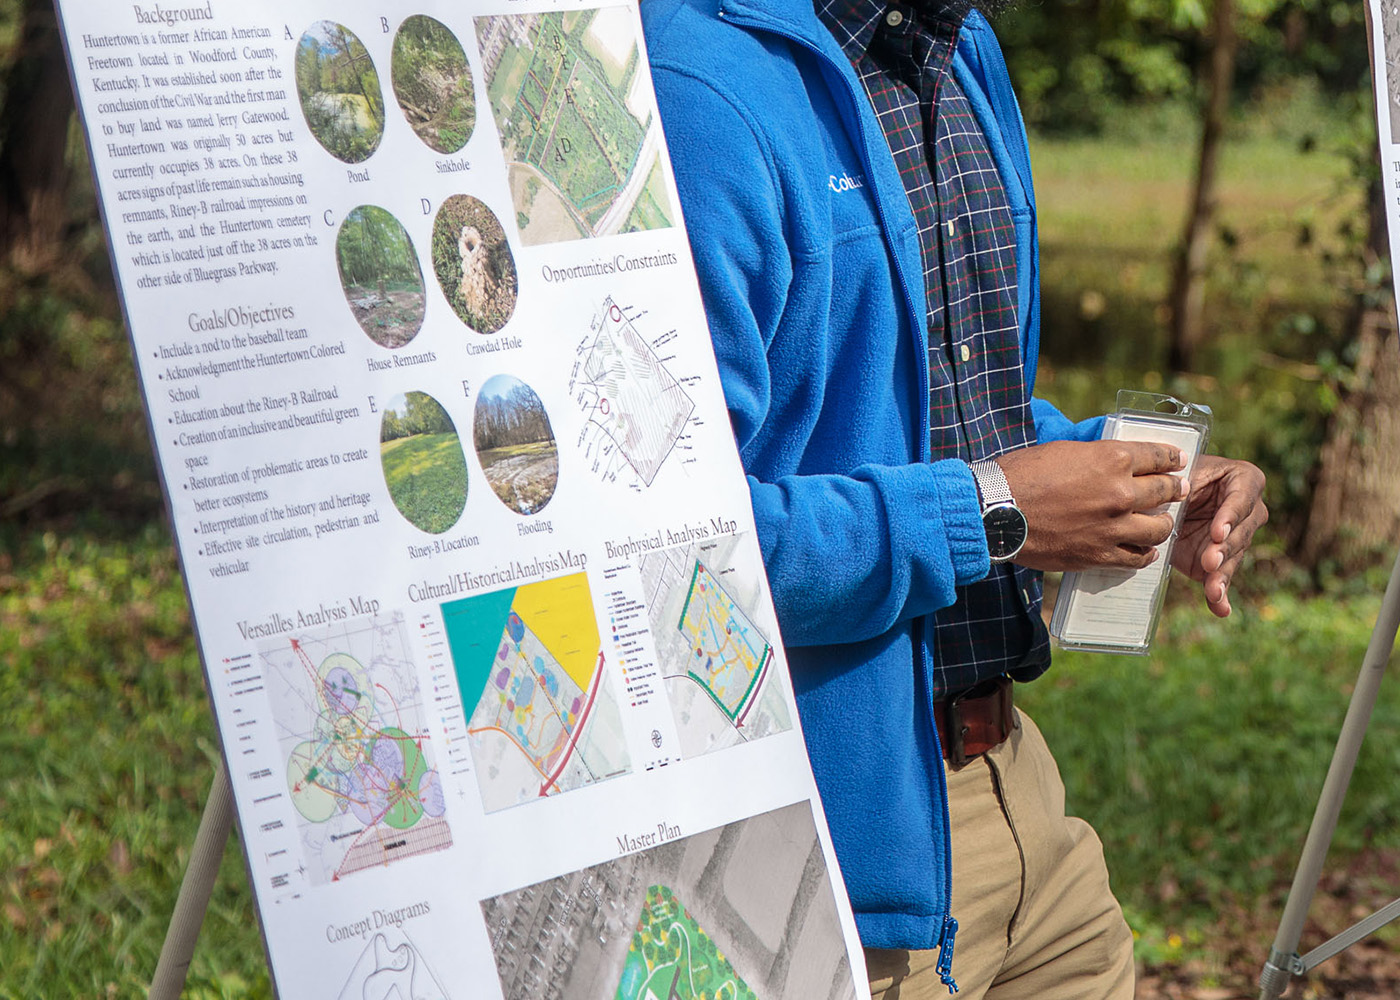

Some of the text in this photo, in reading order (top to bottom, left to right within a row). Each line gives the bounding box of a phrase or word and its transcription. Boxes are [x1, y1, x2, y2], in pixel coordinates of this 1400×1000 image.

[133, 0, 213, 27] Background
[284, 24, 294, 41] A
[380, 16, 390, 34] B
[82, 27, 271, 48] Huntertown is a former African American
[346, 168, 370, 183] Pond
[435, 158, 470, 173] Sinkhole
[420, 198, 431, 216] D
[323, 209, 335, 227] C
[541, 252, 677, 285] Opportunities/Constraints
[187, 302, 294, 332] Goals/Objectives
[465, 335, 522, 355] Crawdad Hole
[366, 351, 436, 371] House Remnants
[461, 379, 470, 398] F
[367, 395, 378, 414] E
[516, 519, 553, 536] Flooding
[407, 535, 479, 559] Riney-B Location
[604, 516, 738, 560] Biophysical Analysis Map
[407, 549, 587, 602] Cultural/Historical Analysis Map
[236, 595, 379, 640] Versailles Analysis Map
[616, 821, 682, 855] Master Plan
[326, 901, 431, 944] Concept Diagrams
